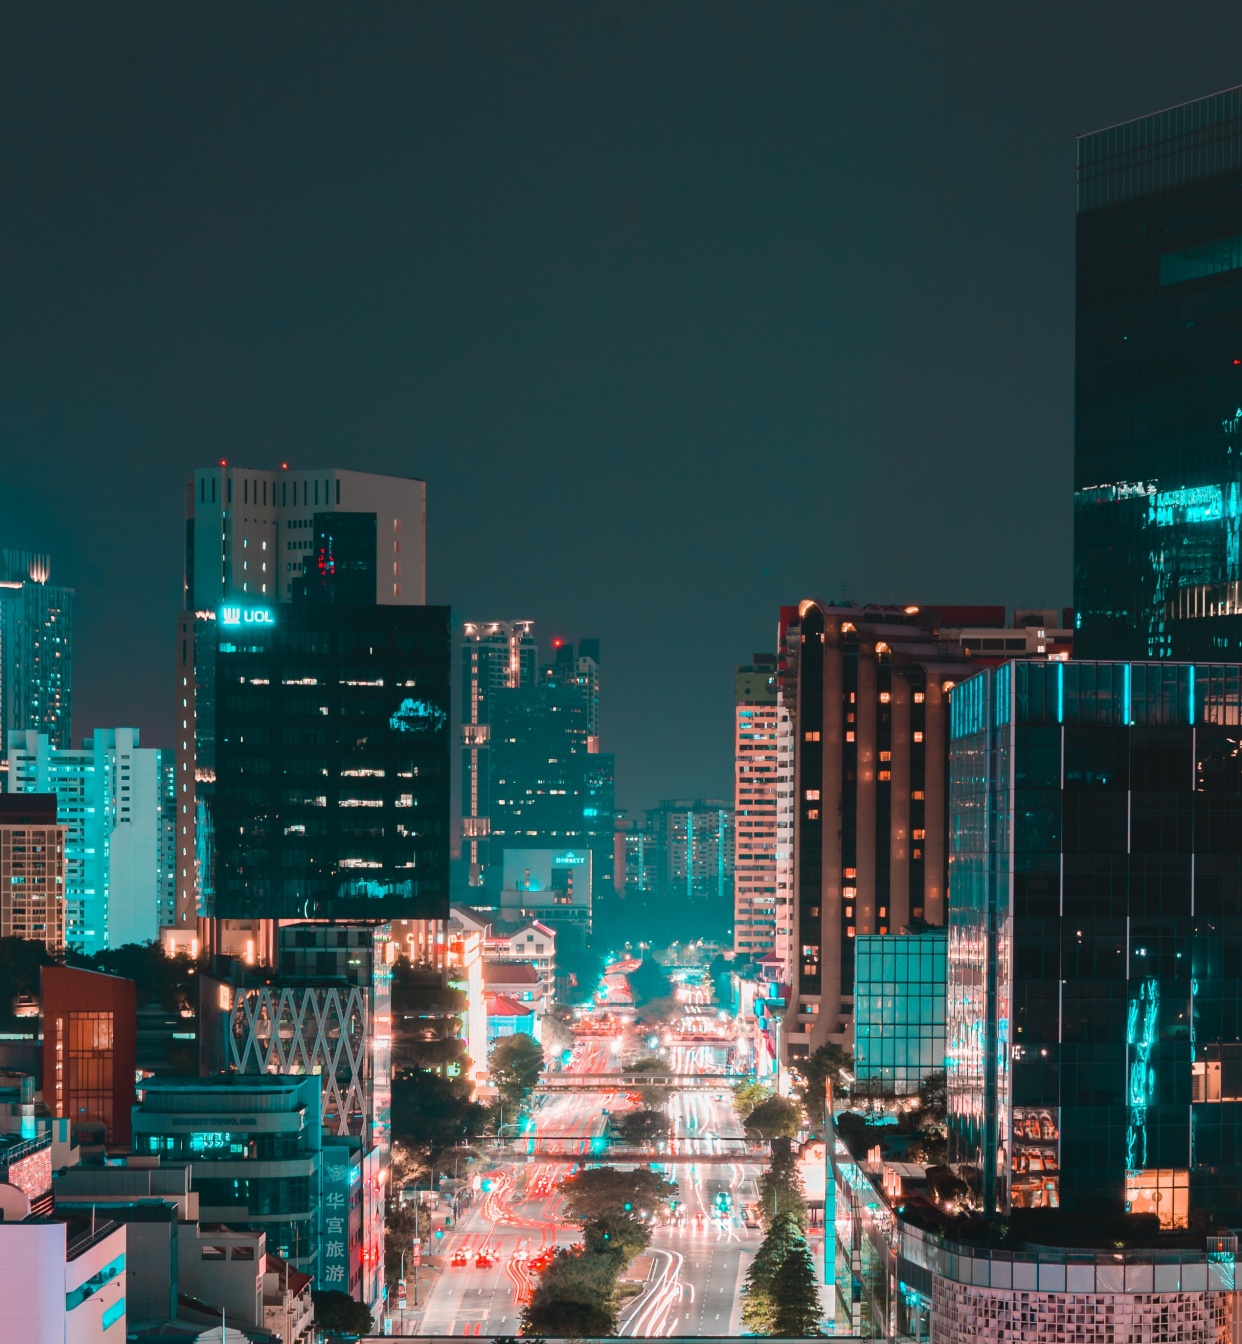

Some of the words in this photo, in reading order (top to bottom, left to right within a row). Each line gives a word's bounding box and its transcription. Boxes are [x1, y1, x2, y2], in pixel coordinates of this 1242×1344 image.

[244, 610, 273, 623] UOL
[325, 1192, 345, 1283] 华宫旅游
